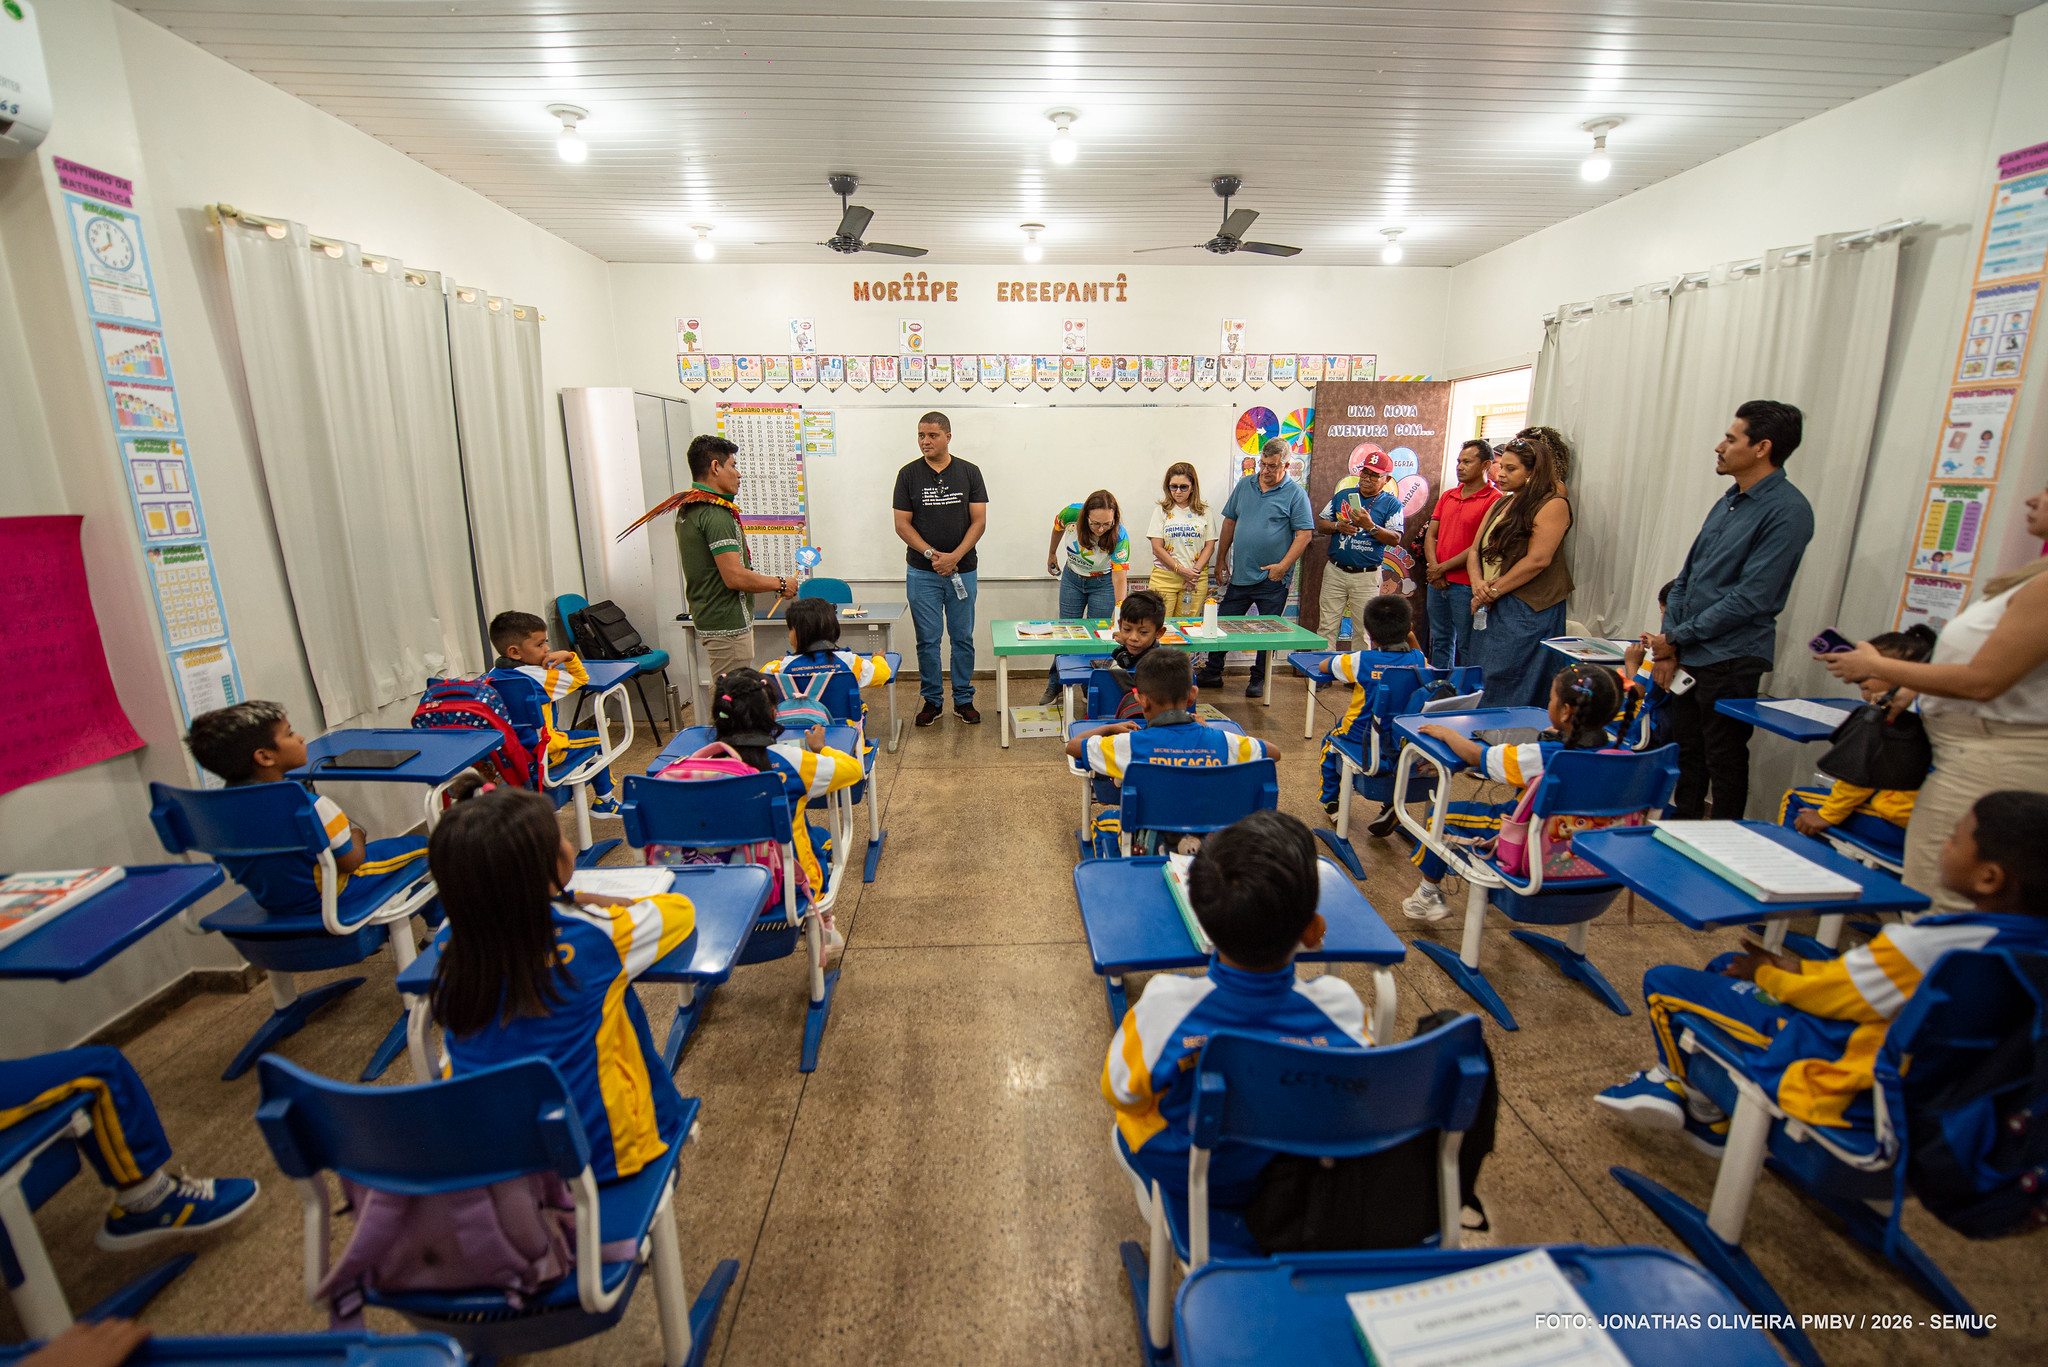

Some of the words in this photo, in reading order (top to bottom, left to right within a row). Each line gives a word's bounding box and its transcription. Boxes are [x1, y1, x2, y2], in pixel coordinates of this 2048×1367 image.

[853, 271, 959, 302] MORÎÎPE
[997, 272, 1128, 302] EREEPANTÎ
[682, 357, 692, 370] A
[710, 357, 720, 370] B
[738, 357, 748, 370] C
[765, 357, 775, 370] D
[794, 357, 803, 370] E
[929, 357, 937, 370] J
[954, 357, 963, 370] K
[982, 357, 992, 370] L
[1063, 357, 1074, 370] O
[1090, 357, 1099, 370] P
[1116, 357, 1127, 370] Q
[1247, 357, 1257, 369] V
[1272, 357, 1285, 369] W
[1300, 357, 1309, 369] X
[1327, 357, 1337, 369] Y
[1353, 357, 1362, 369] Z
[1347, 404, 1375, 417] UMA
[1384, 404, 1418, 417] NOVA
[1327, 424, 1389, 437] AVENTURA
[1394, 423, 1435, 437] COM...
[1402, 481, 1422, 511] MIZADE
